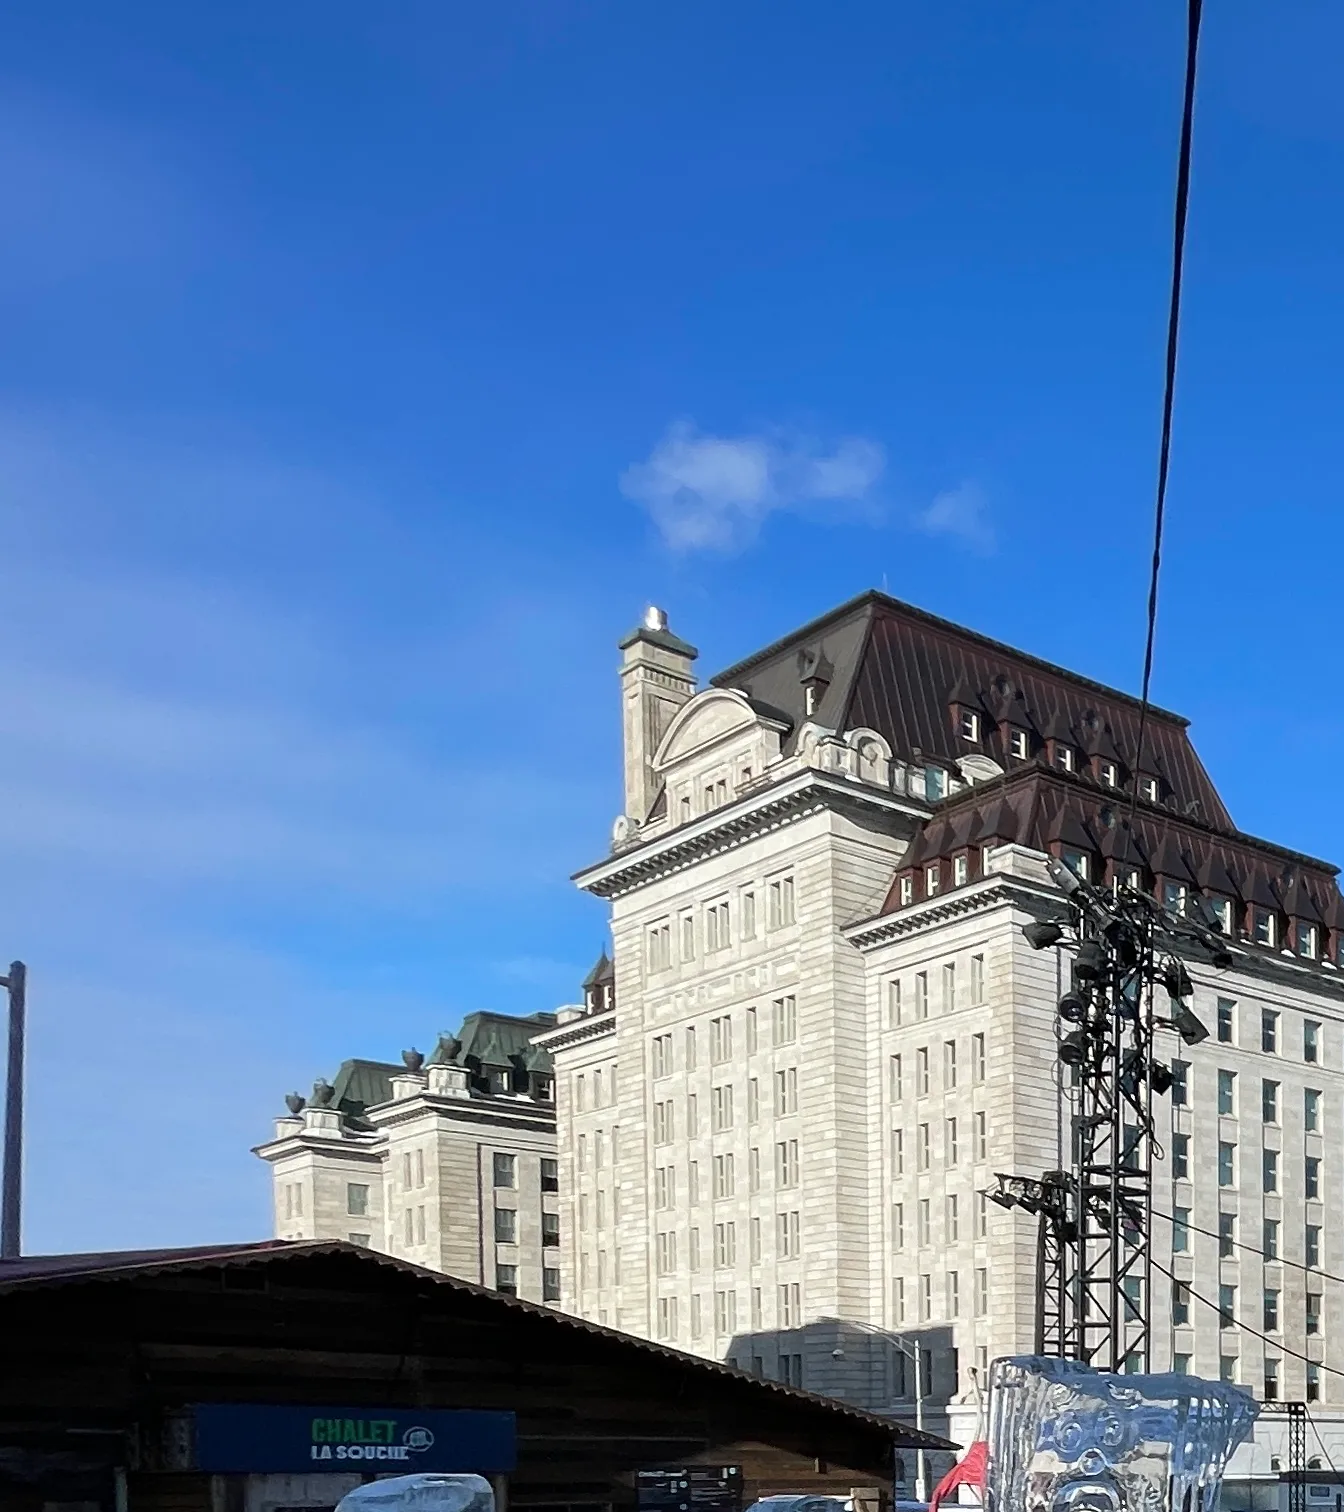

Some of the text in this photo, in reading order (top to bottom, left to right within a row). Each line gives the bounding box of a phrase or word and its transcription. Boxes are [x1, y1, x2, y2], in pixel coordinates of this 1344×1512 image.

[311, 1419, 398, 1443] CHALET
[310, 1445, 409, 1460] LA SOUCHE
